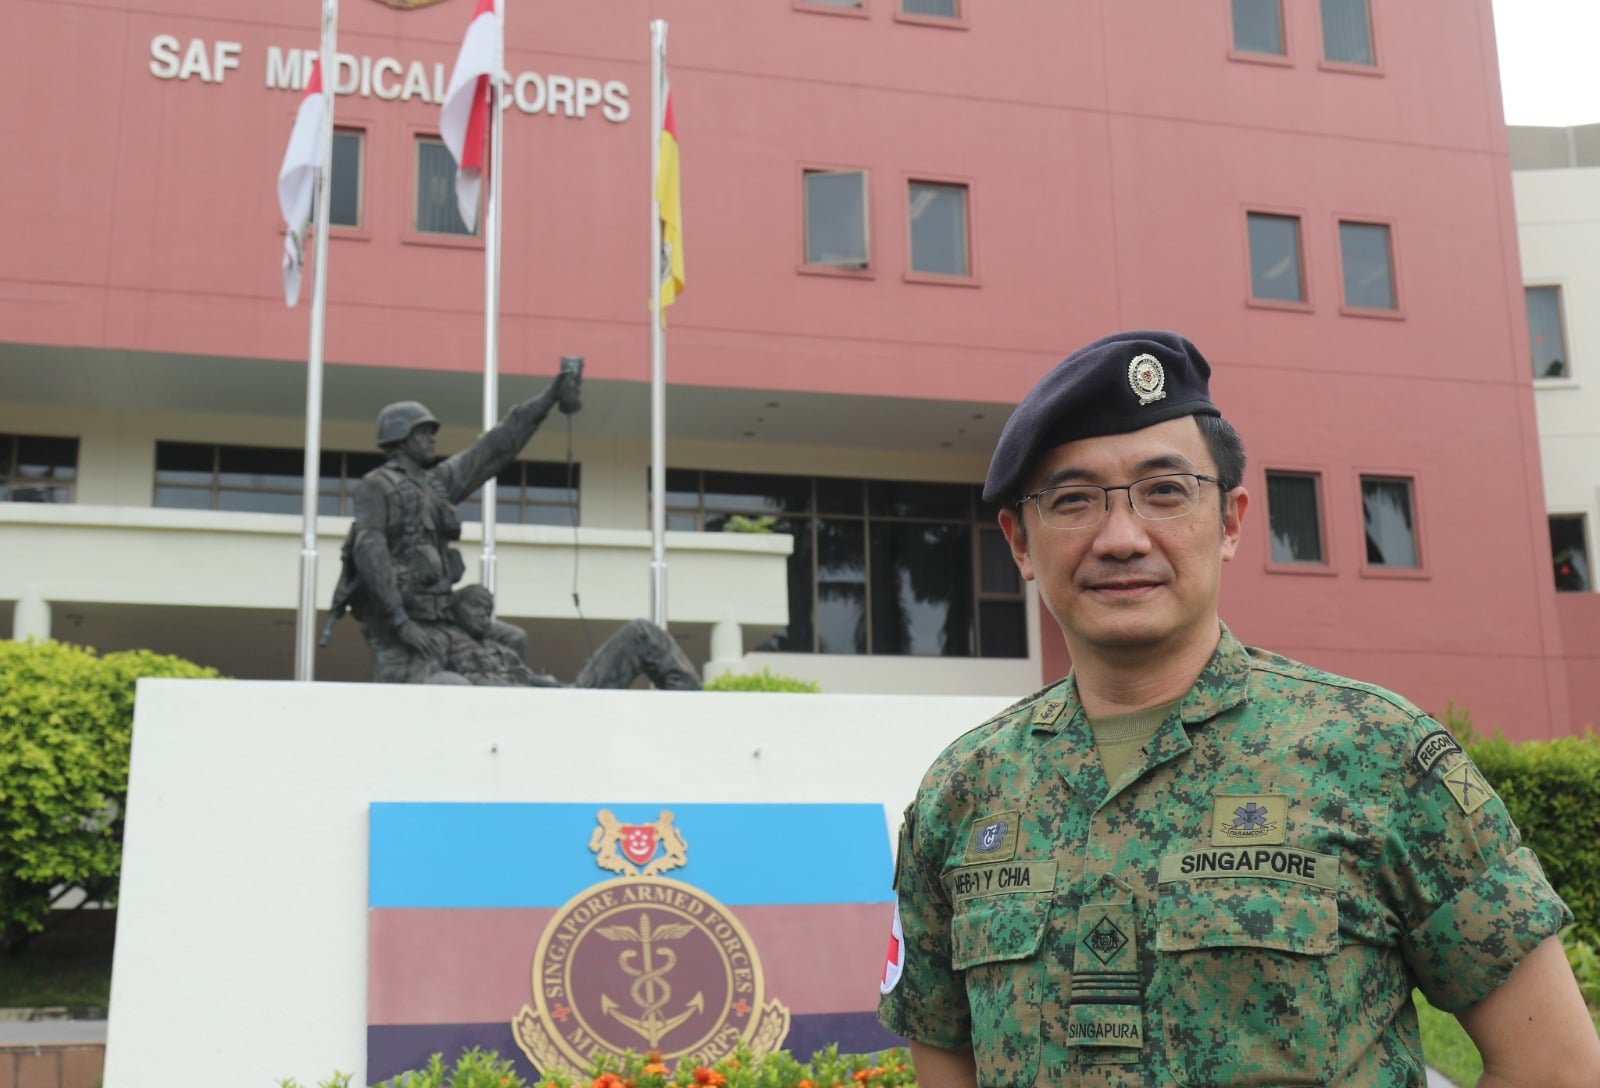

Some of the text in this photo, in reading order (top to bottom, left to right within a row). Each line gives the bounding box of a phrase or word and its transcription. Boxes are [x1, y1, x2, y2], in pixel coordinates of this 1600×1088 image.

[149, 34, 242, 84] SAF
[1419, 735, 1455, 766] RECON
[983, 869, 993, 890] Y
[998, 867, 1031, 888] CHIA
[1180, 850, 1316, 879] SINGAPORE
[545, 886, 752, 998] SINGAPORE ARMED FORCES
[1069, 1023, 1139, 1039] SINGAPURA
